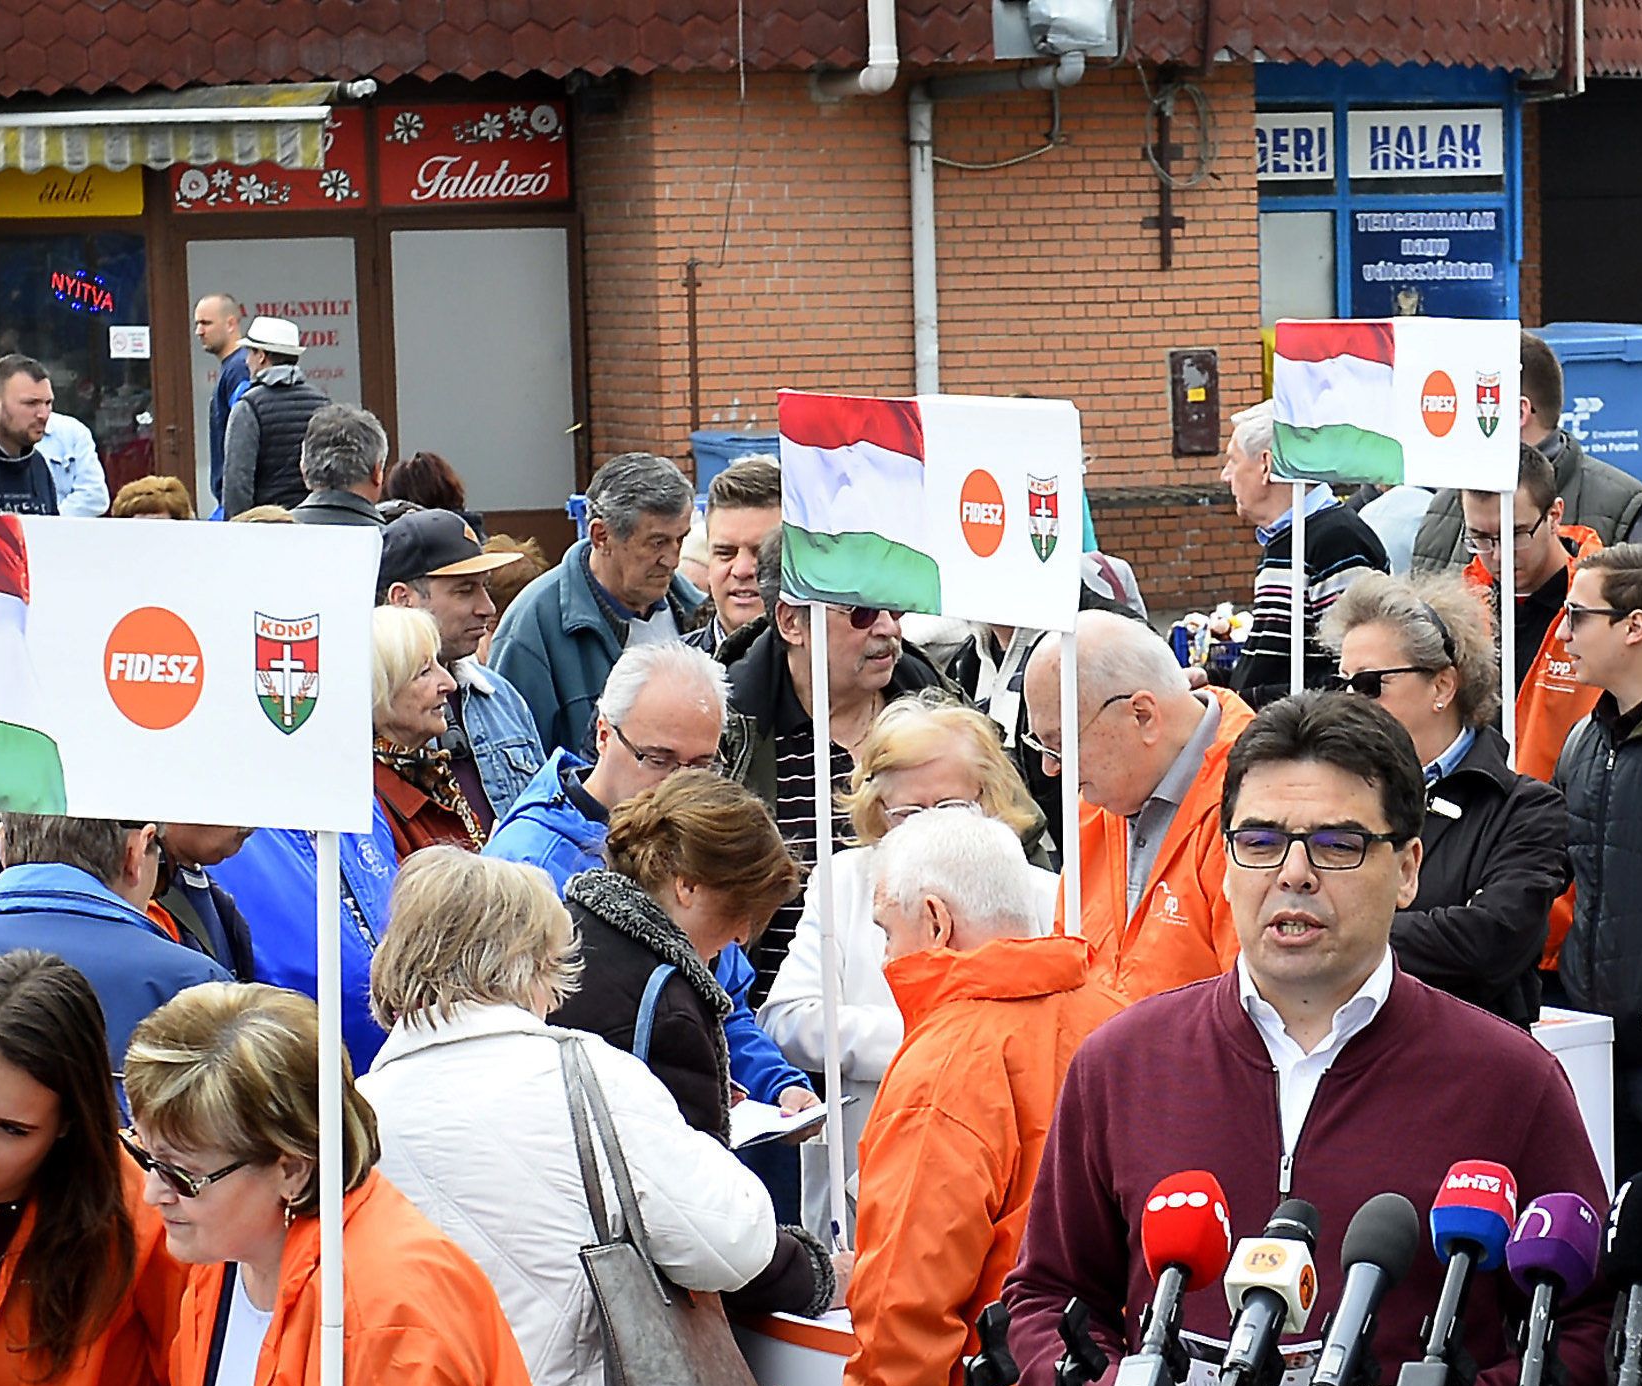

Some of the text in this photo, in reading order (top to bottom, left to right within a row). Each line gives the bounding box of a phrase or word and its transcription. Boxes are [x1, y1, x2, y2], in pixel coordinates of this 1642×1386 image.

[1370, 123, 1482, 171] HALAK
[410, 155, 552, 201] Falatozó
[1400, 237, 1450, 257] nagy
[51, 271, 115, 313] NYITVA
[961, 501, 1004, 526] FIDESZ
[260, 619, 313, 637] KDNP
[109, 652, 199, 684] FIDESZ
[1249, 1252, 1281, 1268] PS
